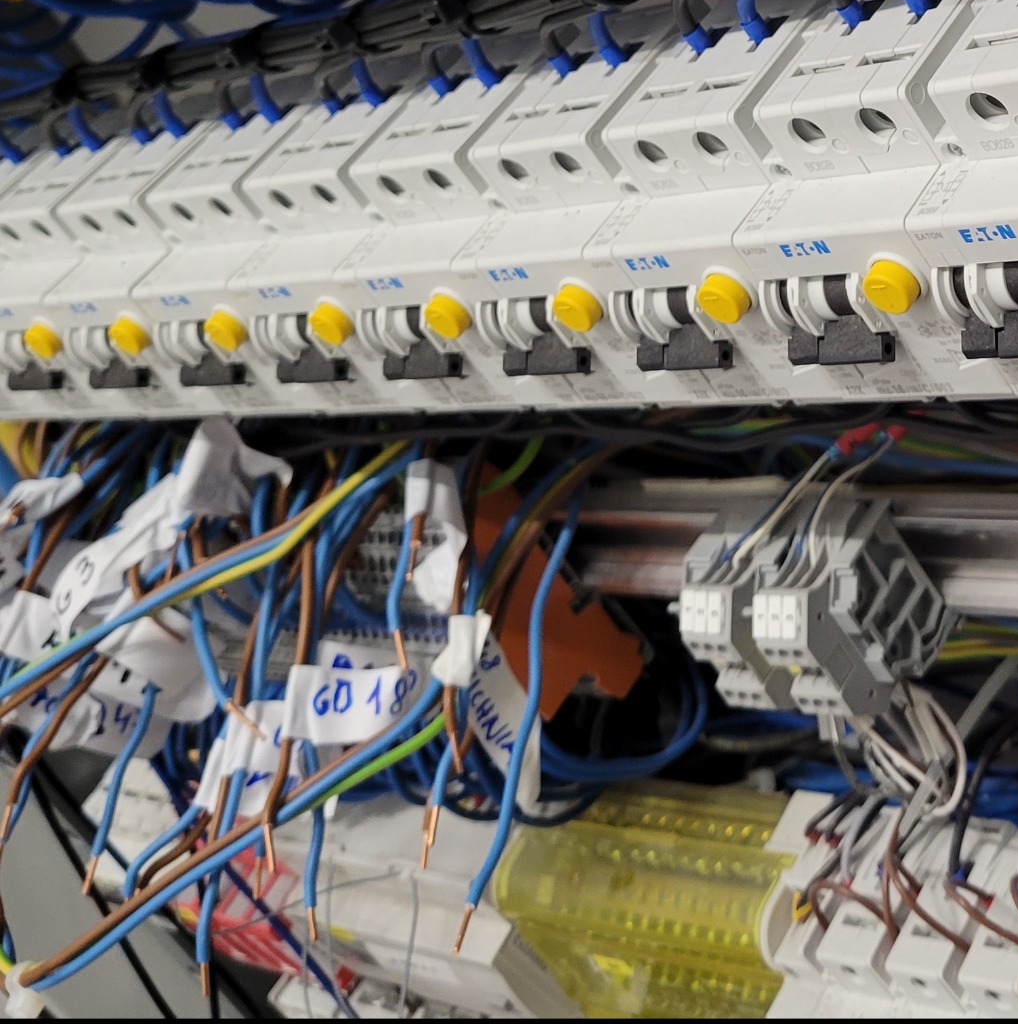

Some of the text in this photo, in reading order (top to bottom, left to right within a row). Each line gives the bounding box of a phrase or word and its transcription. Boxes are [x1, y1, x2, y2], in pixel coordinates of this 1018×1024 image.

[914, 230, 944, 242] EATON
[958, 224, 1018, 244] EATON
[779, 240, 832, 259] EATON
[625, 255, 671, 272] EATON
[488, 266, 530, 282] EATON
